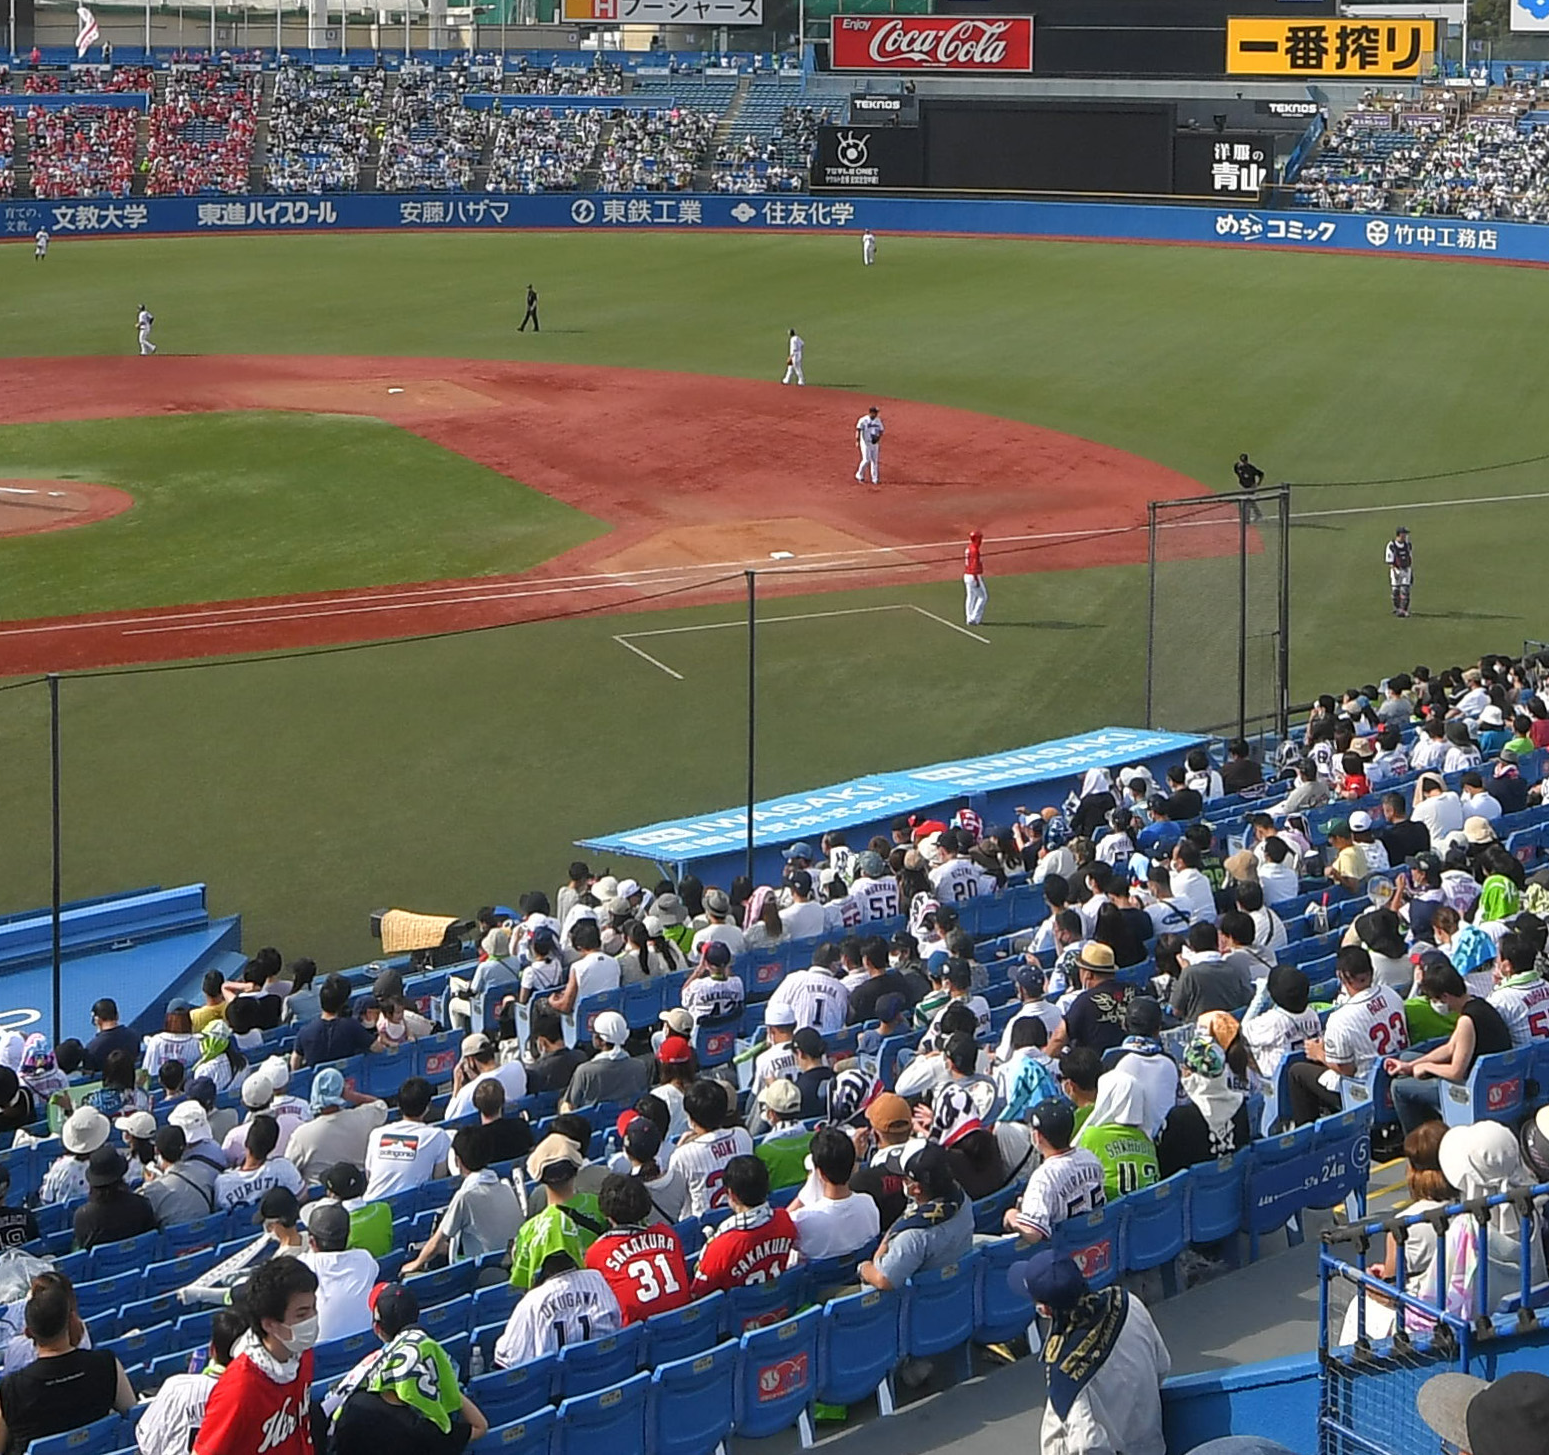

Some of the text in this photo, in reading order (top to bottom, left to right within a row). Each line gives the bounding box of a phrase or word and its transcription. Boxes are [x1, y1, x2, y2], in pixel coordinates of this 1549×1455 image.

[842, 18, 1014, 63] Enjoy Coca-Cola
[1239, 25, 1421, 70] 一番搾り
[854, 99, 901, 110] TEKNOS
[1268, 103, 1318, 114] TEKNOS
[1214, 143, 1265, 161] 洋服の
[1211, 162, 1267, 191] 青山
[52, 202, 148, 230] 文教大学
[197, 201, 338, 226] 東進ハイスクール
[400, 200, 510, 224] 安藤ハザマ
[602, 199, 703, 224] 東鉄工業
[762, 200, 855, 226] 住友化学
[1214, 213, 1337, 242] めちゃコミック
[1394, 222, 1498, 250] 竹中工務店
[688, 784, 885, 833] IWASAKI
[953, 879, 978, 901] 20
[869, 896, 898, 921] 55
[813, 998, 823, 1027] 1
[1369, 1011, 1409, 1055] 23
[605, 1231, 675, 1273] SAKAKURA
[627, 1253, 681, 1304] 31
[541, 1292, 599, 1320] OKUGAWA
[554, 1314, 591, 1347] 11
